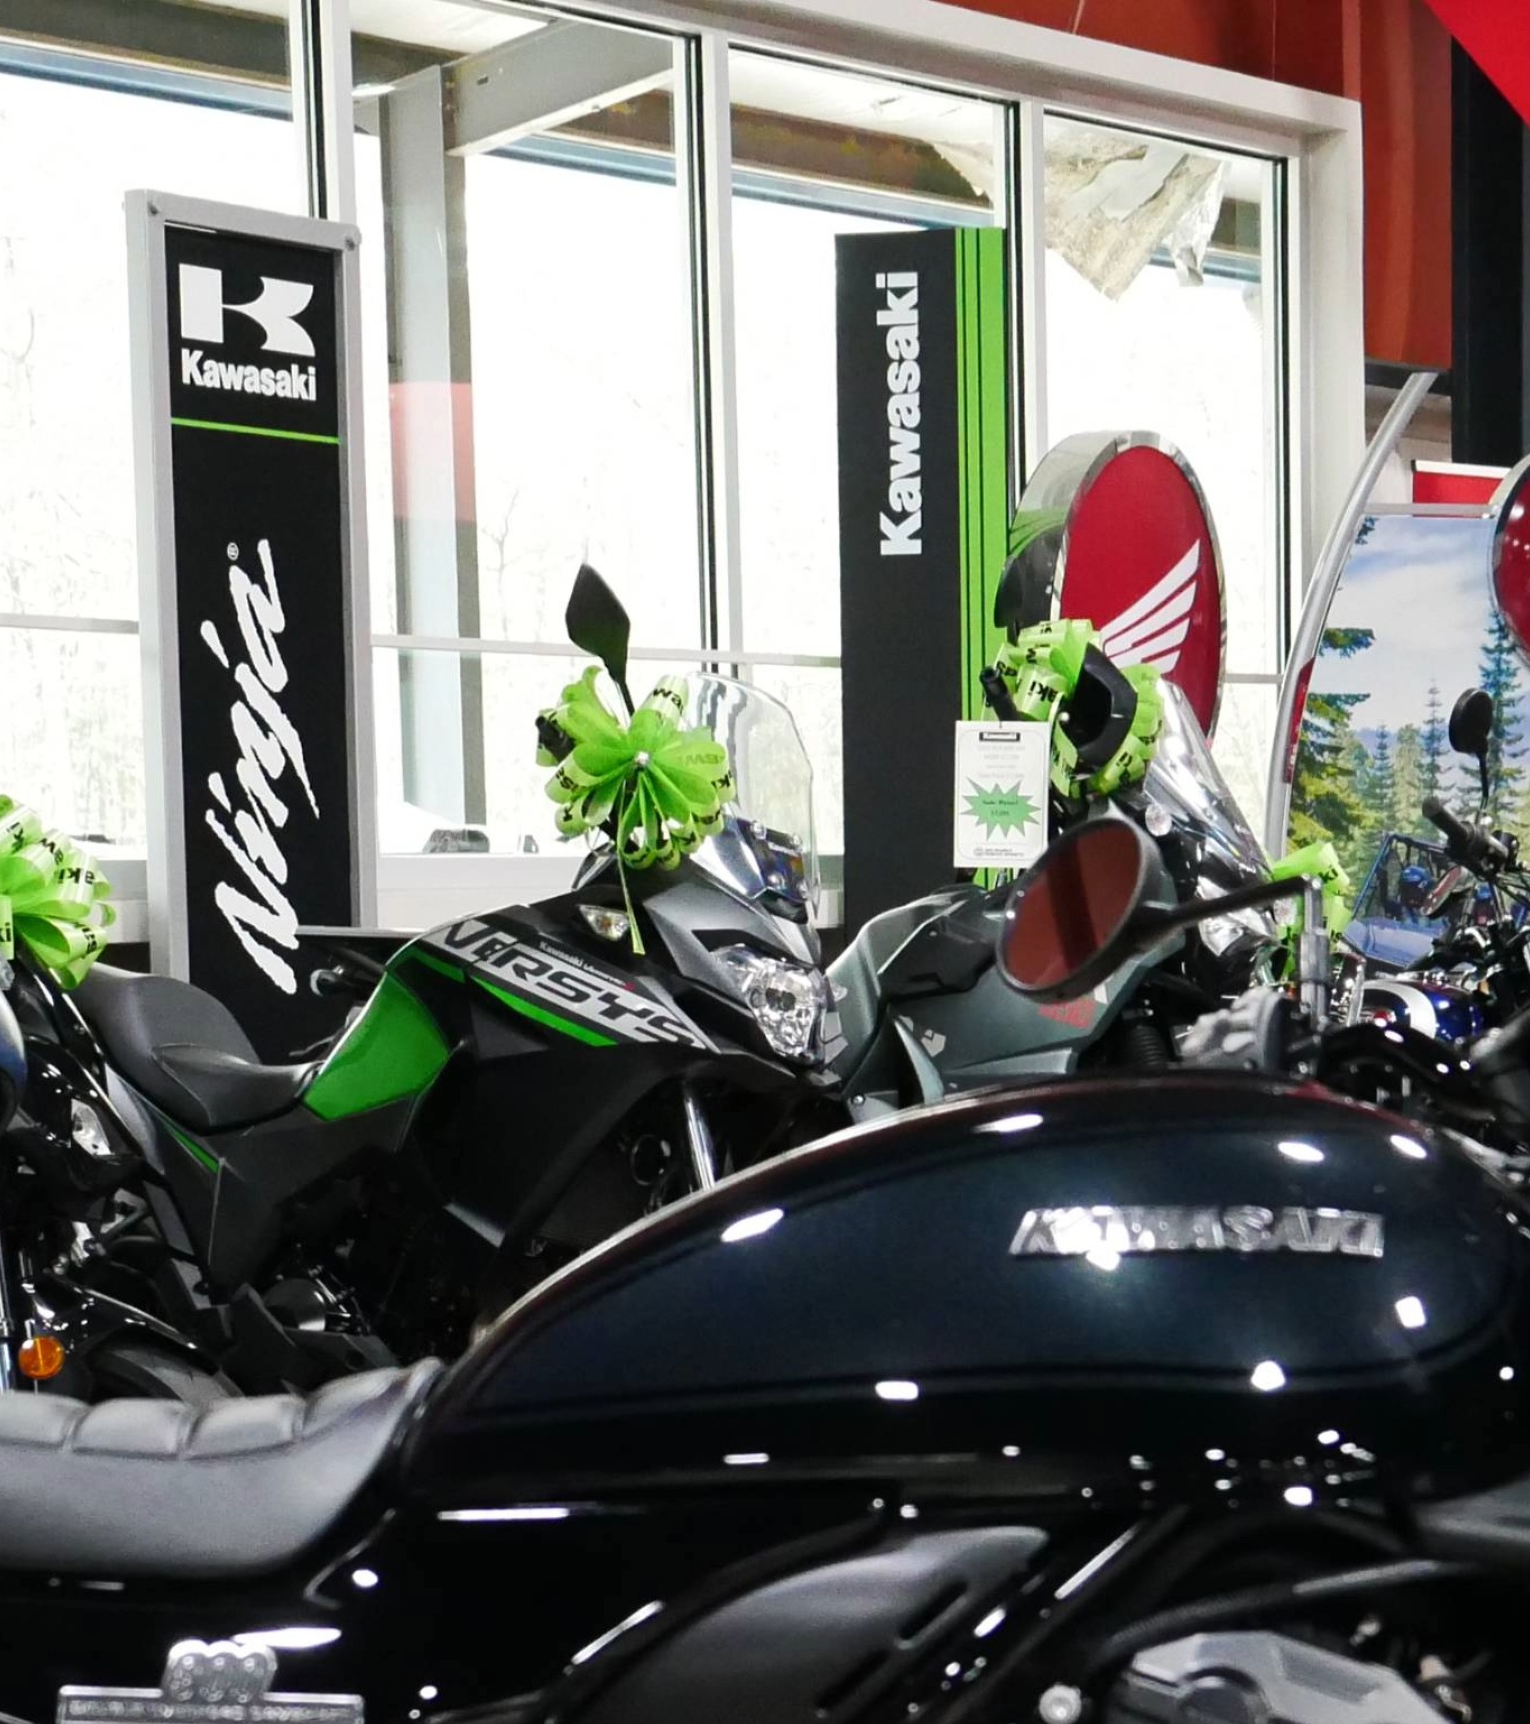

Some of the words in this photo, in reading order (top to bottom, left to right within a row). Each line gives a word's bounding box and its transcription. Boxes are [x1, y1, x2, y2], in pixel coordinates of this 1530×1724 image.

[181, 347, 317, 402] Kawasaki
[876, 270, 923, 557] Kawasaki
[444, 918, 707, 1050] VERSYS
